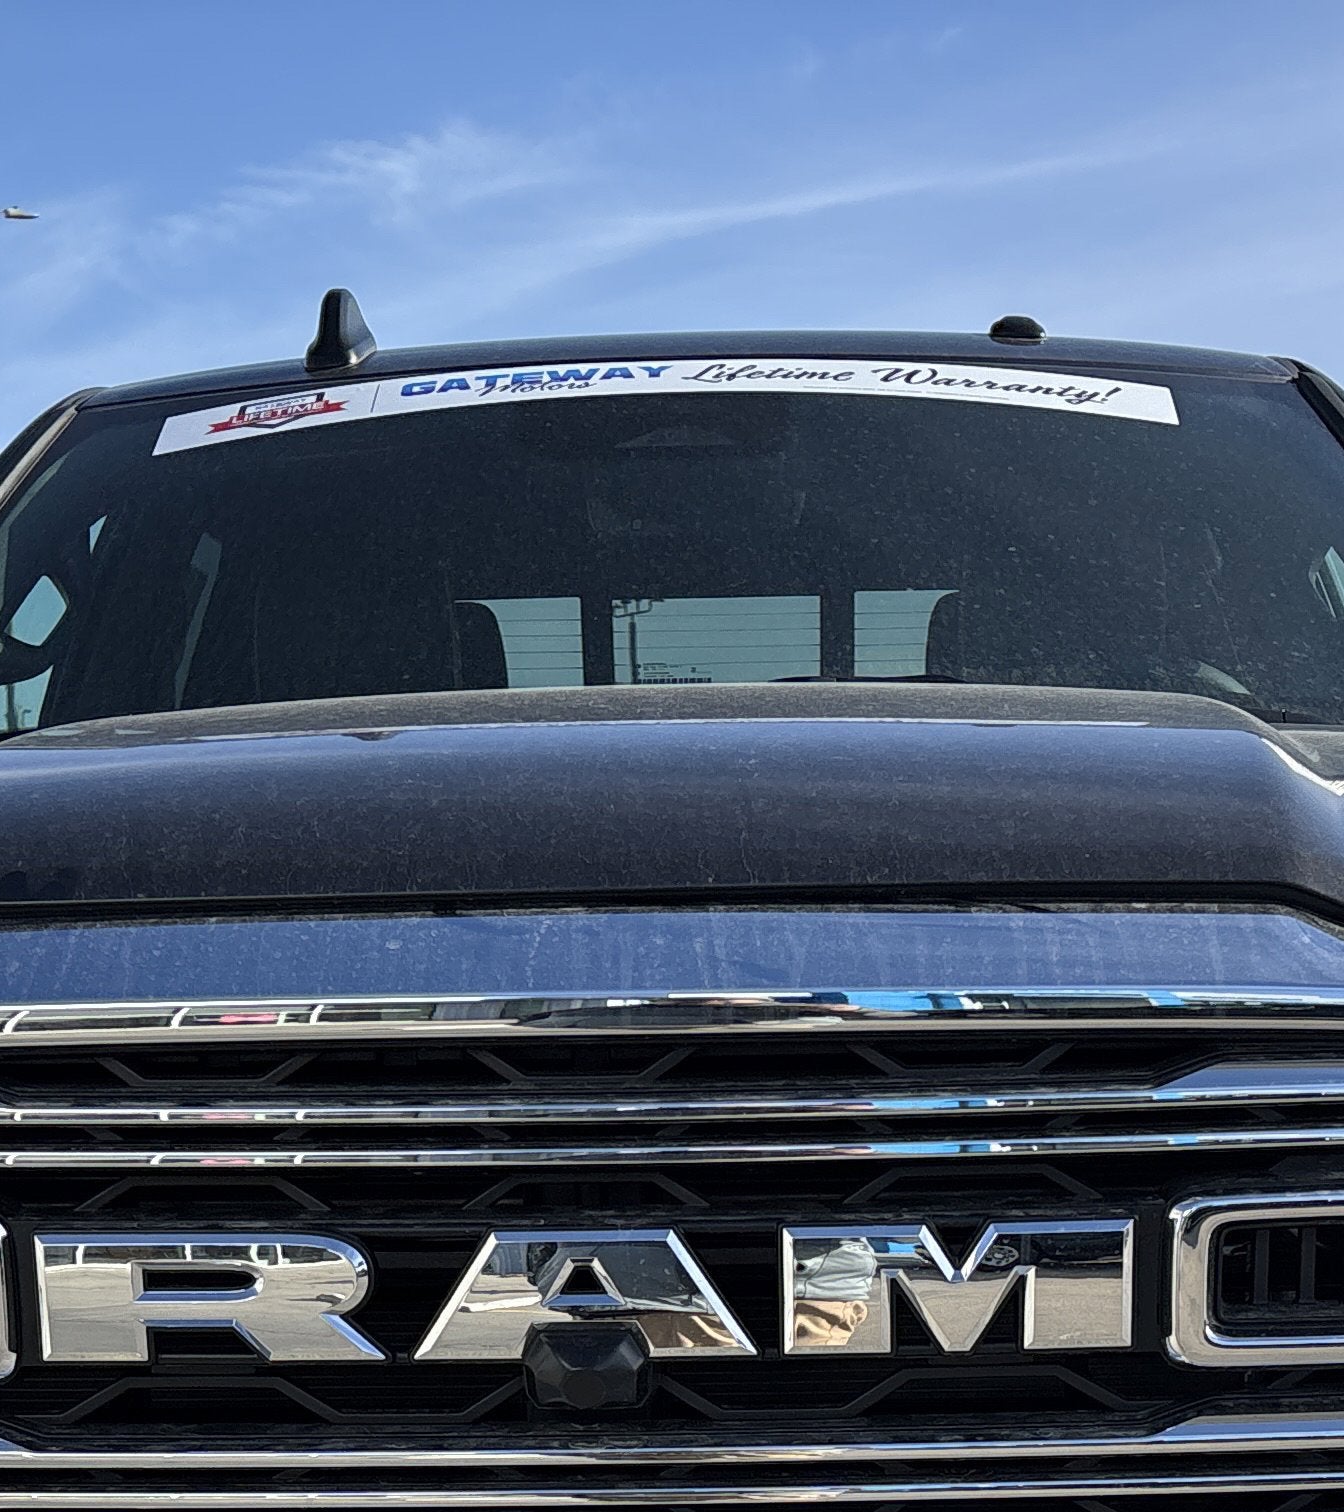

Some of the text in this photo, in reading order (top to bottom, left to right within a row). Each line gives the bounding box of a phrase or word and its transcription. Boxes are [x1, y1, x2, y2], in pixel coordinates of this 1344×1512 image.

[400, 364, 674, 397] GATEWAY
[476, 377, 597, 397] Motors
[681, 363, 856, 383] Lifetime
[872, 367, 1123, 405] Warranty!
[230, 401, 326, 425] LIFETIME
[34, 1218, 1137, 1364] RAM
